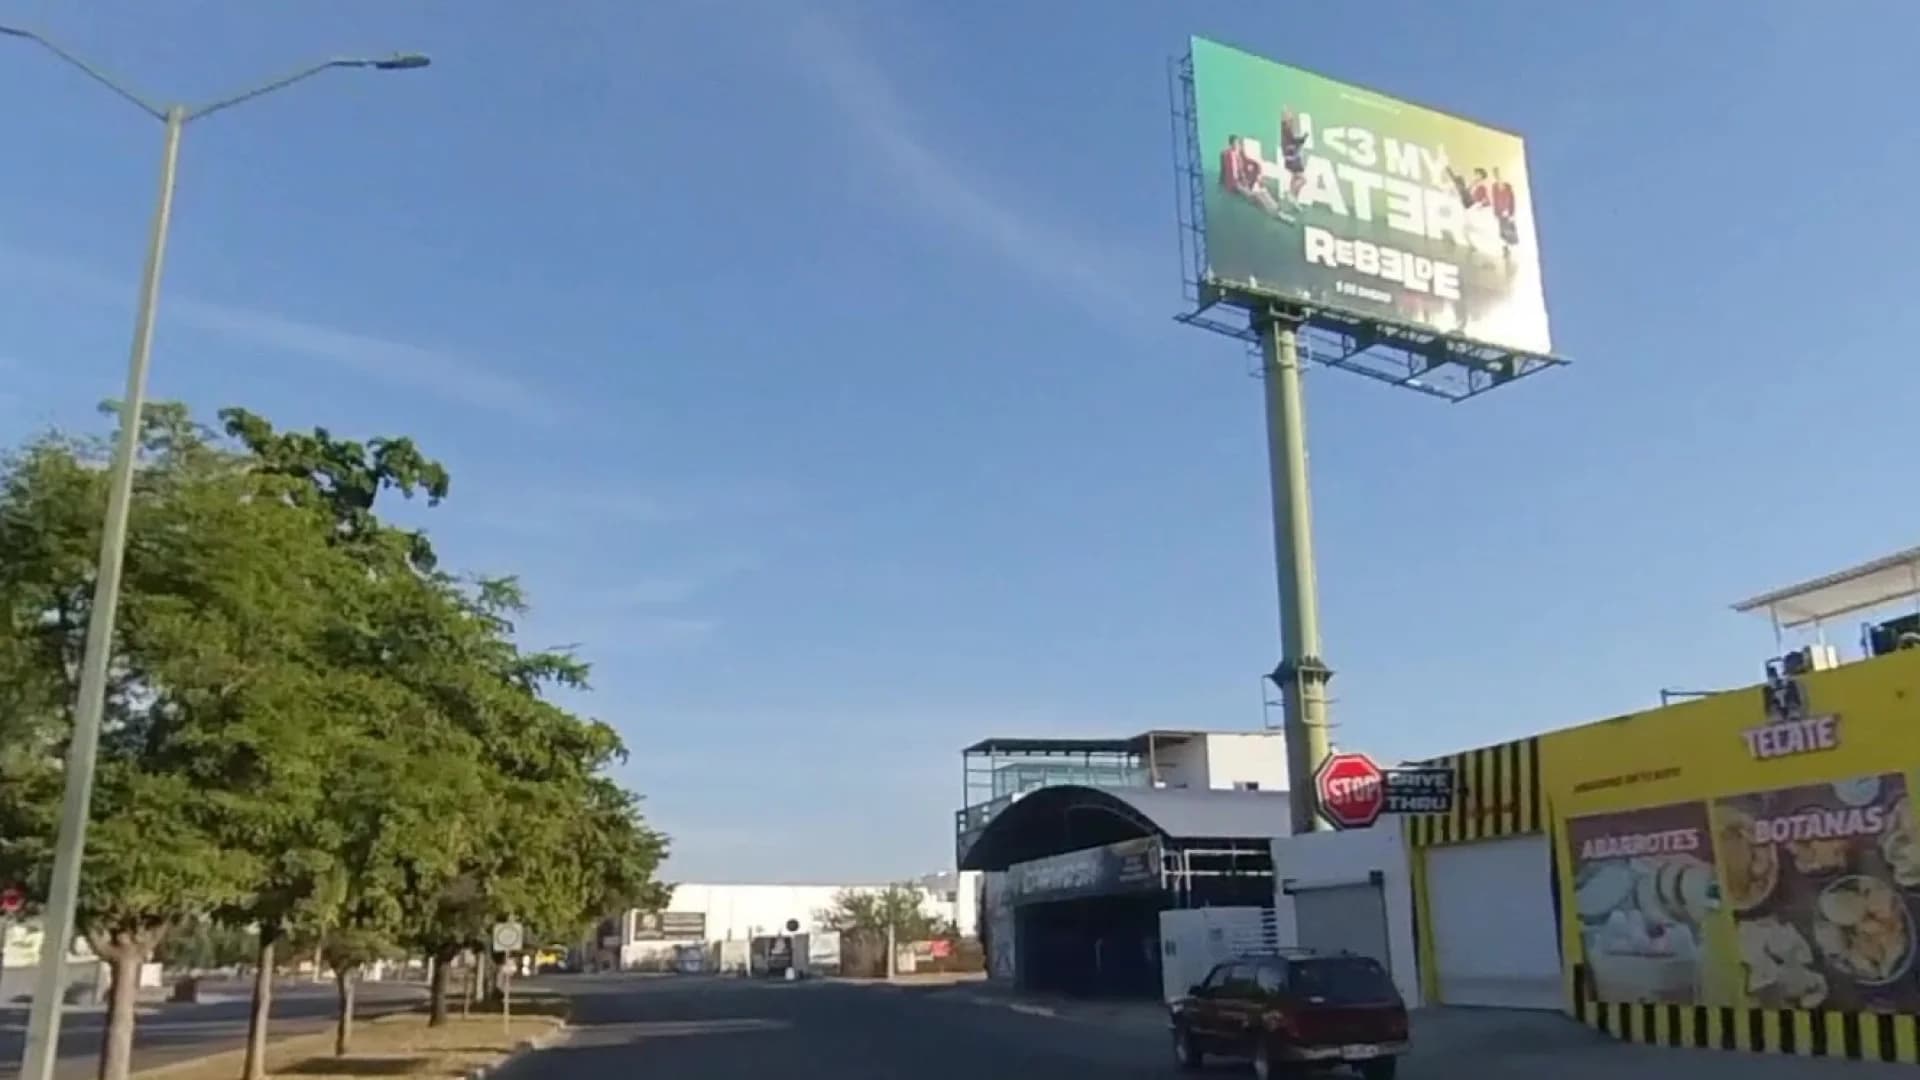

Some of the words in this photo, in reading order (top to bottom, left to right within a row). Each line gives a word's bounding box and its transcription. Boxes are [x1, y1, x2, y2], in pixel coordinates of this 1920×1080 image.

[1383, 137, 1451, 190] MY
[1242, 136, 1508, 258] HATERS
[1741, 715, 1838, 758] TECATE
[1328, 773, 1382, 804] STOP
[1387, 771, 1447, 787] DRIVE
[1388, 796, 1447, 810] THRU
[1753, 806, 1884, 843] BOTANAS
[1582, 828, 1699, 859] ABARROTES
